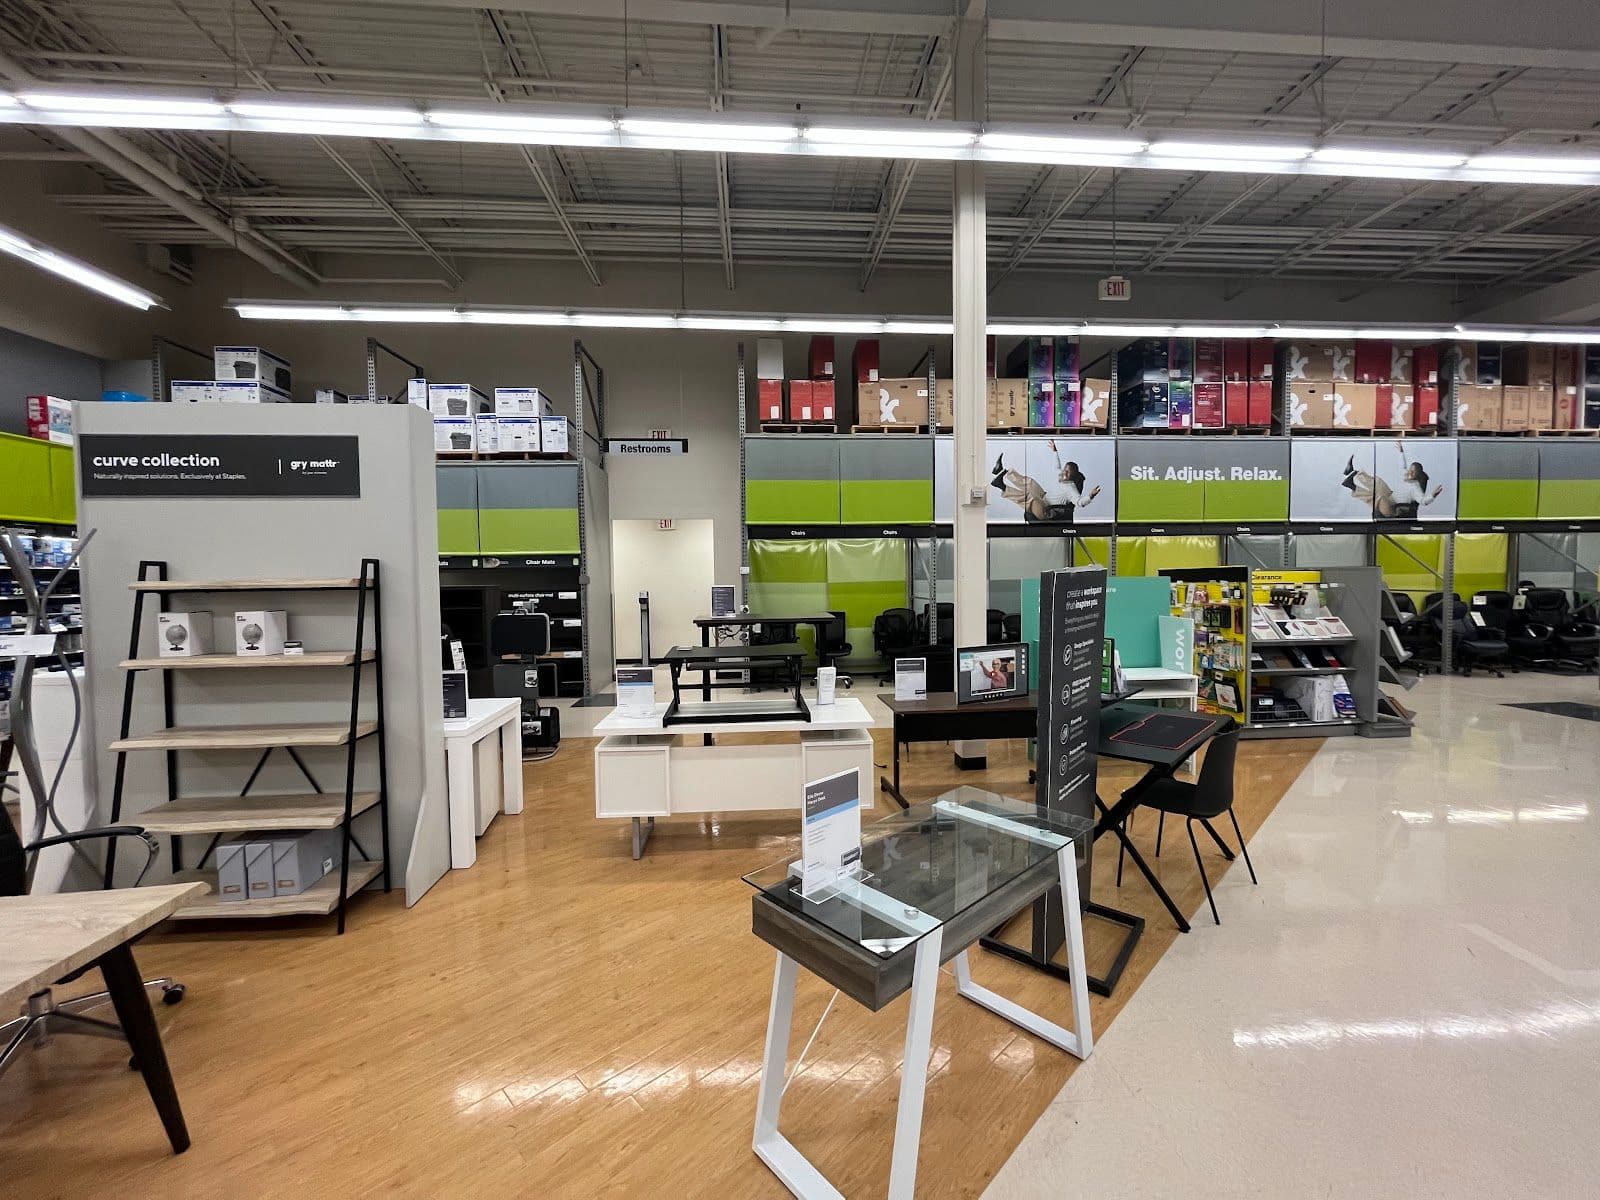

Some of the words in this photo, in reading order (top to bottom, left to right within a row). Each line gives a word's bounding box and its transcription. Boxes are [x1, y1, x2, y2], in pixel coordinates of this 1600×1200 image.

[1106, 282, 1125, 296] EXIT
[652, 430, 667, 439] EXIT
[620, 444, 671, 454] Restrooms
[92, 456, 138, 466] curve
[142, 453, 220, 466] collection
[290, 460, 307, 470] gry
[1130, 466, 1159, 481] Sit.
[1165, 466, 1225, 483] Adjust.
[1231, 466, 1282, 481] Relax.
[660, 519, 672, 528] EXIT
[1175, 628, 1185, 670] wor
